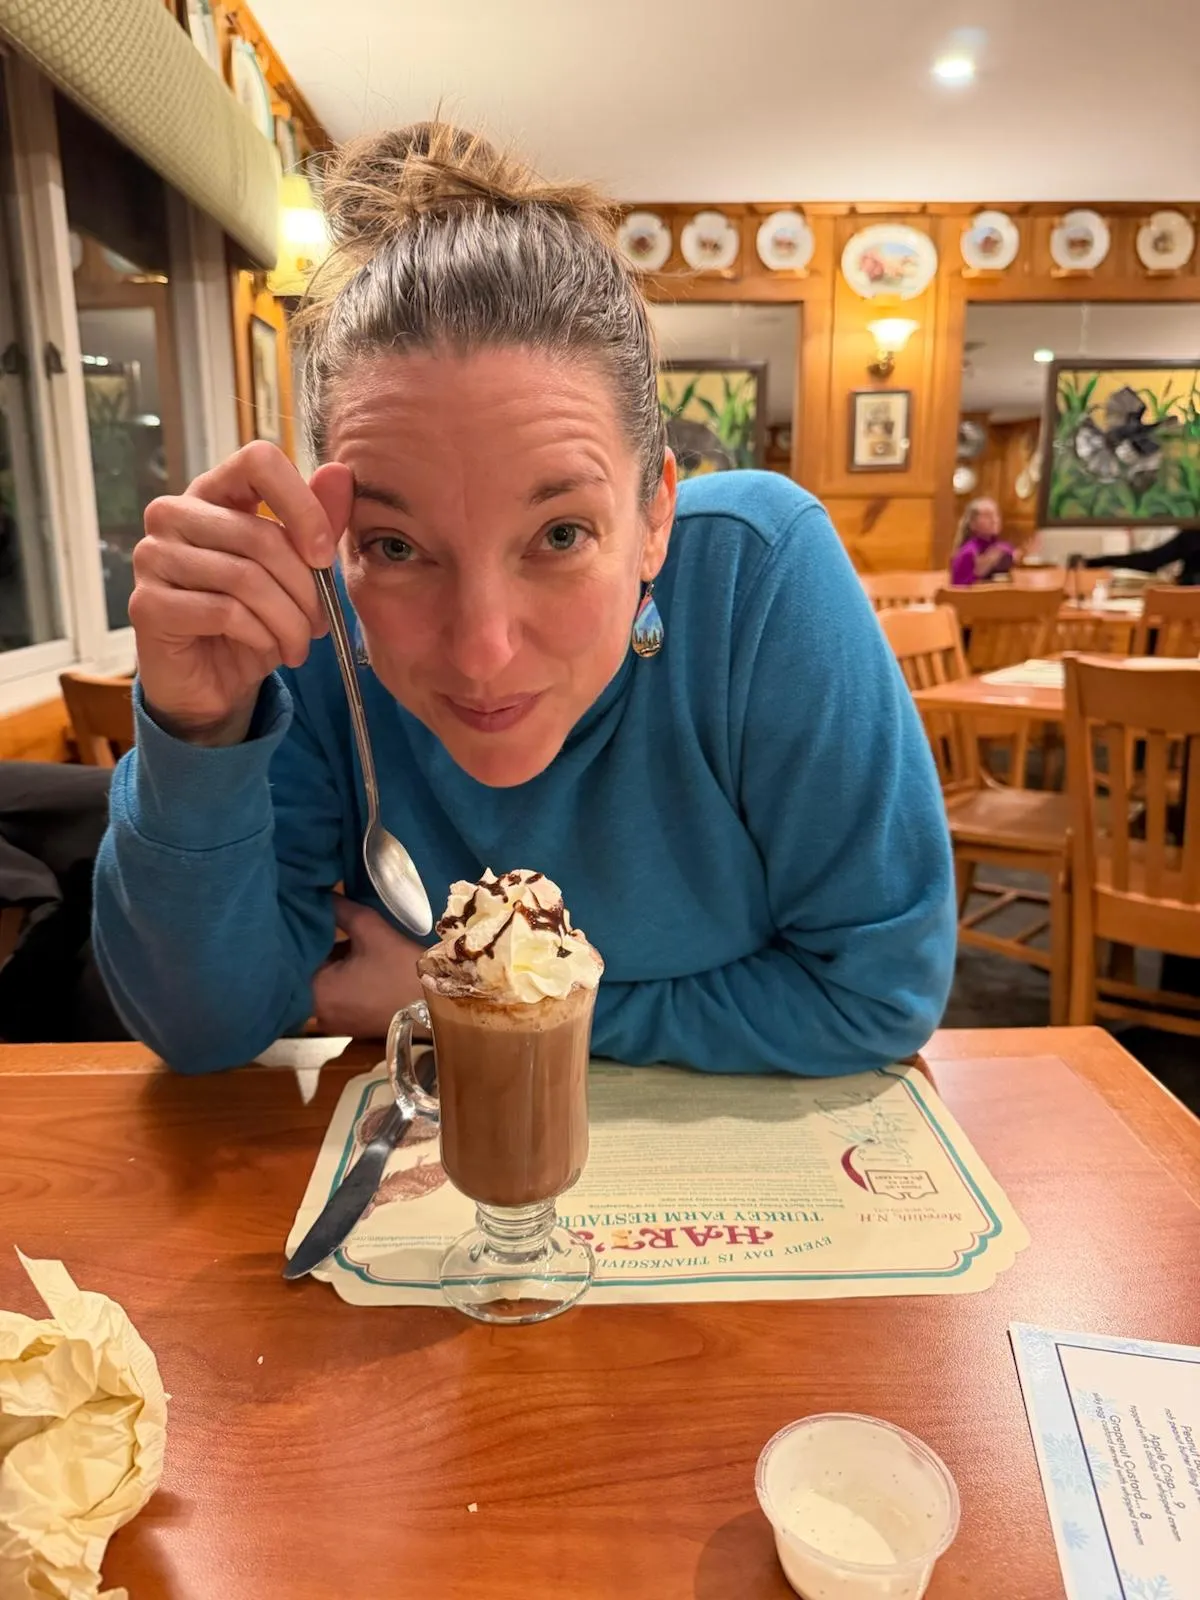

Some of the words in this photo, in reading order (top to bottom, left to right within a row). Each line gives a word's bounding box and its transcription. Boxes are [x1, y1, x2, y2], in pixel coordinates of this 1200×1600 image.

[557, 1212, 657, 1229] RESTAUR
[665, 1210, 726, 1223] FARM
[735, 1210, 825, 1223] TURKEY
[784, 1235, 833, 1256] EVERY
[578, 1251, 710, 1270] THANKSGIVIG
[718, 1253, 735, 1264] IS
[744, 1248, 774, 1261] DAY
[1108, 1414, 1132, 1458] Grapenut
[1139, 1511, 1153, 1520] 8
[1148, 1433, 1169, 1461] Apple
[1172, 1501, 1186, 1509] 9
